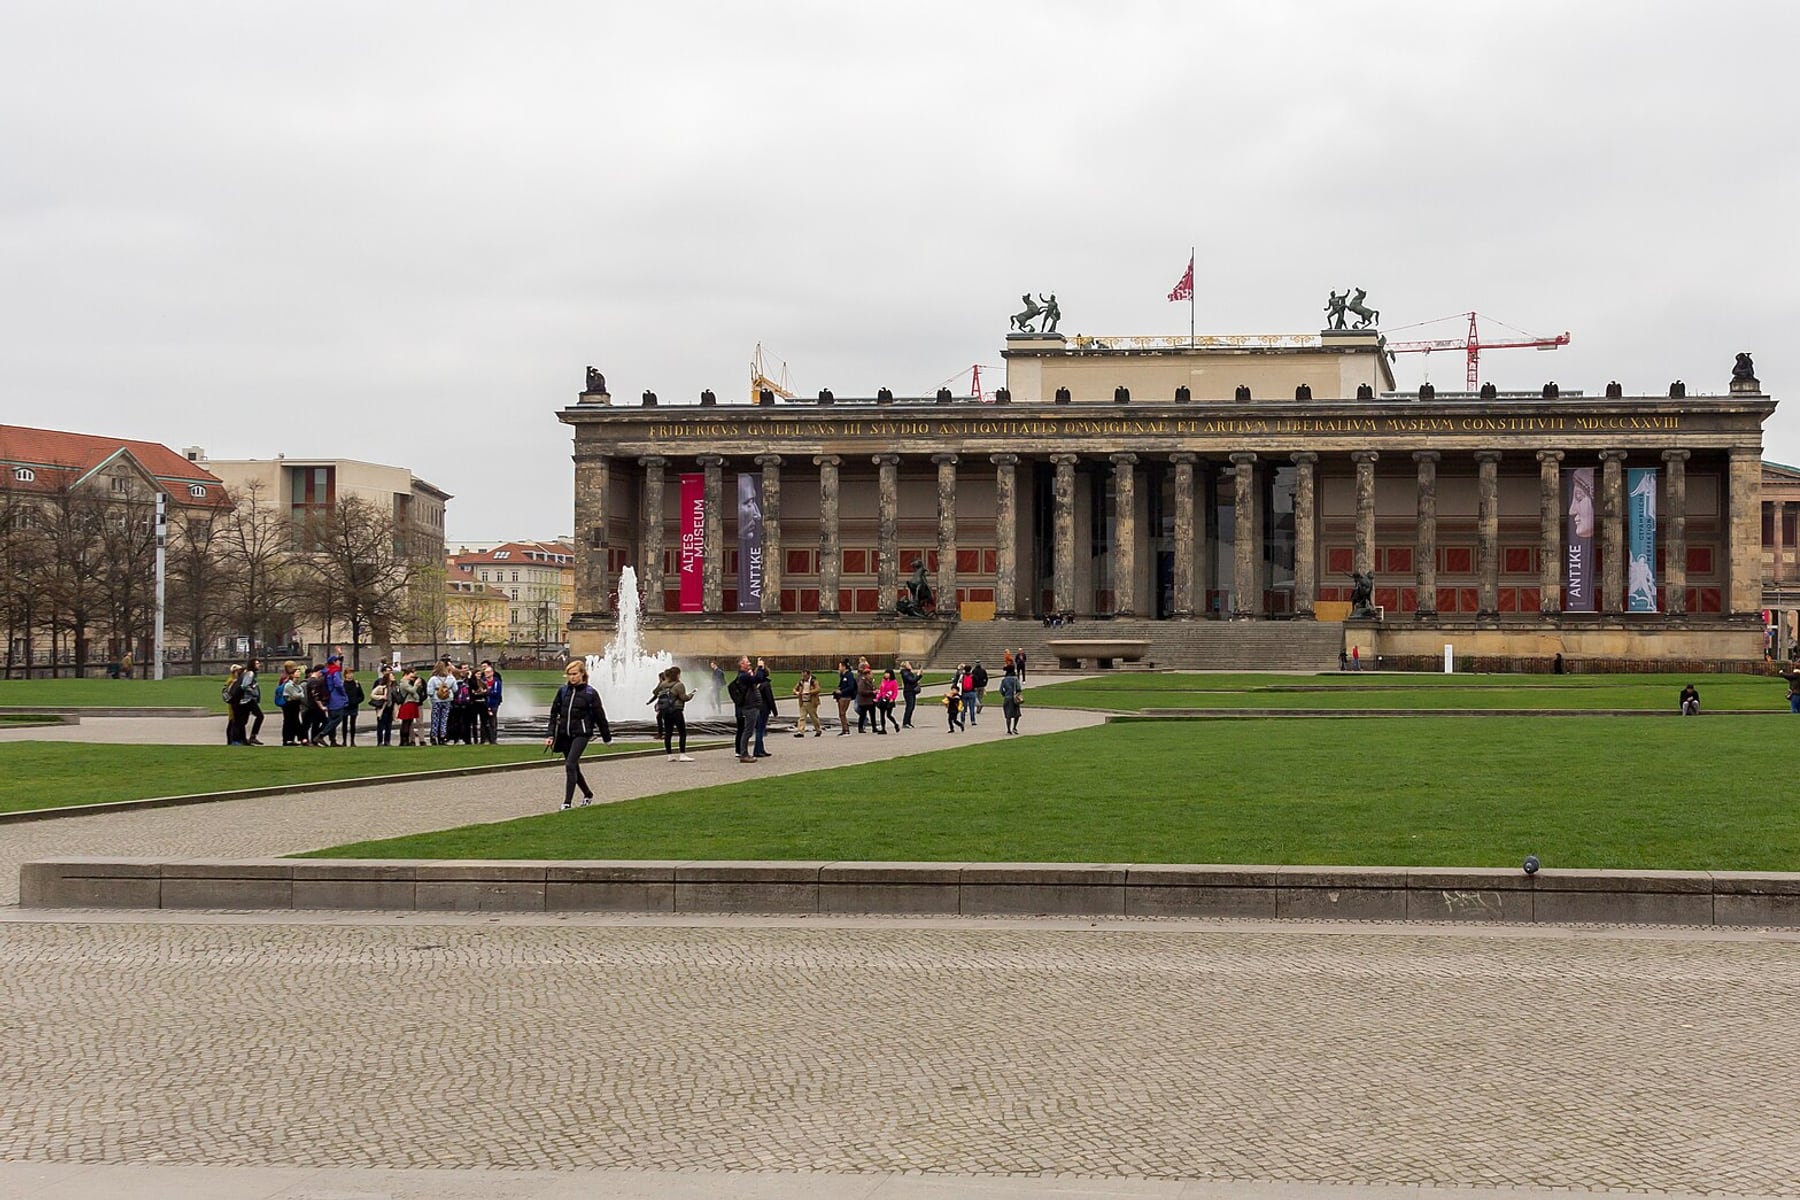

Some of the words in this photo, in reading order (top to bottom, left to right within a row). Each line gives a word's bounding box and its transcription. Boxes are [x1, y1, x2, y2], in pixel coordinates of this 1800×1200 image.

[649, 423, 739, 437] FRIDERICVS
[844, 423, 860, 434] III
[870, 422, 929, 434] STVDIO
[939, 422, 1057, 434] ANTIQVITATIS
[1064, 421, 1169, 433] OMNIGENAE
[1178, 421, 1197, 432] ET
[1204, 420, 1268, 432] ARTIVM
[1276, 419, 1377, 432] LIBERALIVM
[1385, 418, 1454, 431] MVSEVM
[1462, 418, 1566, 430] CONSTITVIT
[683, 533, 694, 573] ALTES
[694, 499, 704, 557] MUSEUM
[750, 547, 761, 598] ANTIKE
[1569, 544, 1581, 598] ANTIKE
